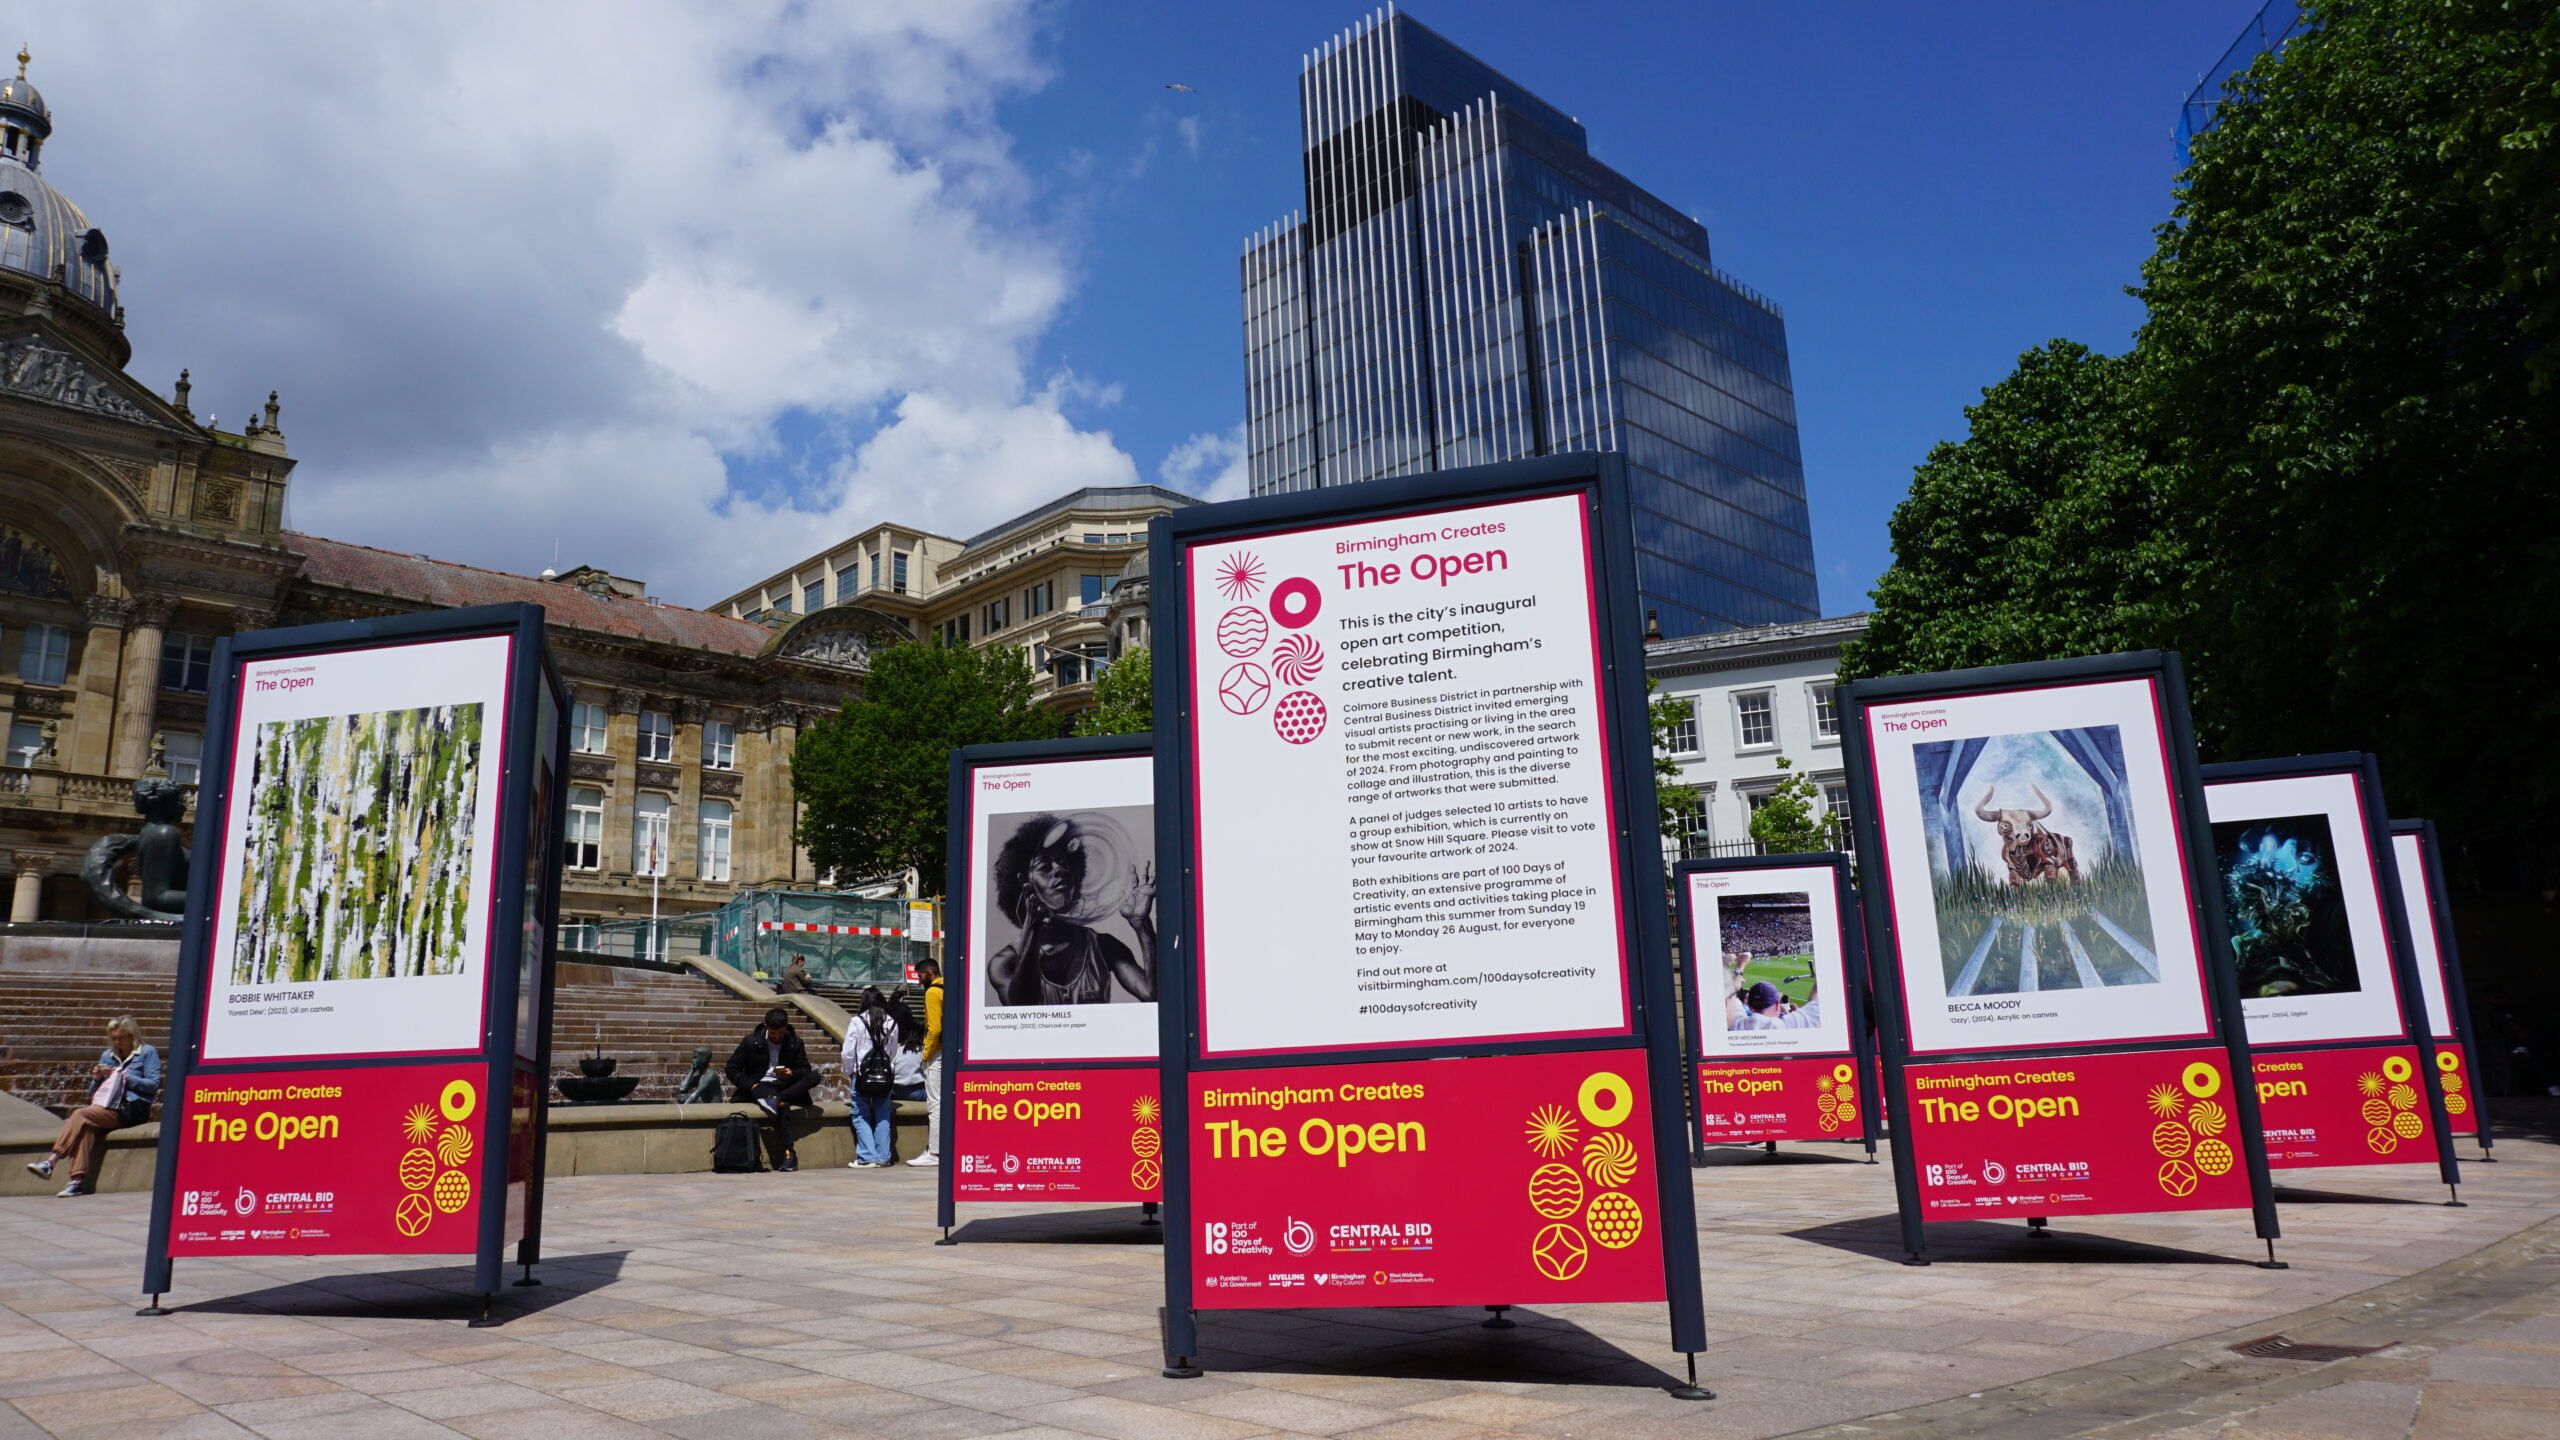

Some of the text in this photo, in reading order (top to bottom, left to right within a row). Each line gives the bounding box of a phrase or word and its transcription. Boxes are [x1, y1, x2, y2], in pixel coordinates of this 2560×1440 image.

[1336, 522, 1505, 554] Birmingham Creates
[1336, 549, 1507, 589] The Open
[1339, 594, 1535, 630] This is the city's inaugural
[1340, 621, 1504, 652] open art competition,
[1341, 637, 1542, 670] celebrating Birmingham's
[255, 677, 313, 691] The Open
[1342, 668, 1456, 691] creative talent.
[1343, 701, 1388, 712] Colmore
[1390, 696, 1437, 707] Business
[1440, 690, 1477, 702] District
[1492, 681, 1556, 698] partnership
[1559, 678, 1582, 688] with
[1343, 694, 1568, 725] Central Business District invited emerging
[1344, 727, 1375, 738] visual
[1378, 724, 1411, 734] artists
[1414, 718, 1468, 733] practising
[1484, 713, 1514, 723] living
[1516, 711, 1526, 719] in
[1529, 709, 1547, 718] the
[1549, 707, 1575, 716] area
[1882, 718, 1947, 732] The Open
[1358, 738, 1395, 749] submit
[1397, 734, 1432, 745] recent
[1448, 732, 1470, 740] new
[1472, 727, 1501, 737] work,
[1504, 725, 1514, 734] in
[1517, 724, 1535, 732] the
[1538, 719, 1575, 730] search
[982, 780, 1030, 791] The Open
[1357, 966, 1595, 991] visitbirmingham.com/100daysofcreativity
[228, 990, 314, 1003] BOBBIE WHITTAKER
[1359, 998, 1477, 1014] #100daysofcreativity
[1947, 1000, 2020, 1012] BECCA MOODY
[1702, 1068, 1750, 1077] Birmingham
[2258, 1062, 2304, 1072] Creates
[963, 1080, 1081, 1094] Birmingham Creates
[1703, 1078, 1783, 1096] The Open
[1915, 1070, 2075, 1090] Birmingham Creates
[194, 1084, 342, 1105] Birmingham Creates
[1203, 1082, 1424, 1110] Birmingham Creates
[2255, 1081, 2307, 1104] pen
[963, 1098, 1080, 1127] The Open
[1918, 1094, 2079, 1127] The Open
[192, 1111, 338, 1149] The Open
[1204, 1117, 1426, 1167] The Open
[2015, 1161, 2088, 1173] CENTRAL BID
[265, 1191, 333, 1203] CENTRAL BID
[1231, 1229, 1247, 1238] 100
[1329, 1223, 1432, 1238] CENTRAL BID
[1231, 1237, 1262, 1247] Days of
[1231, 1245, 1273, 1254] Creativity
[1330, 1237, 1432, 1246] BIRMINGHAM
